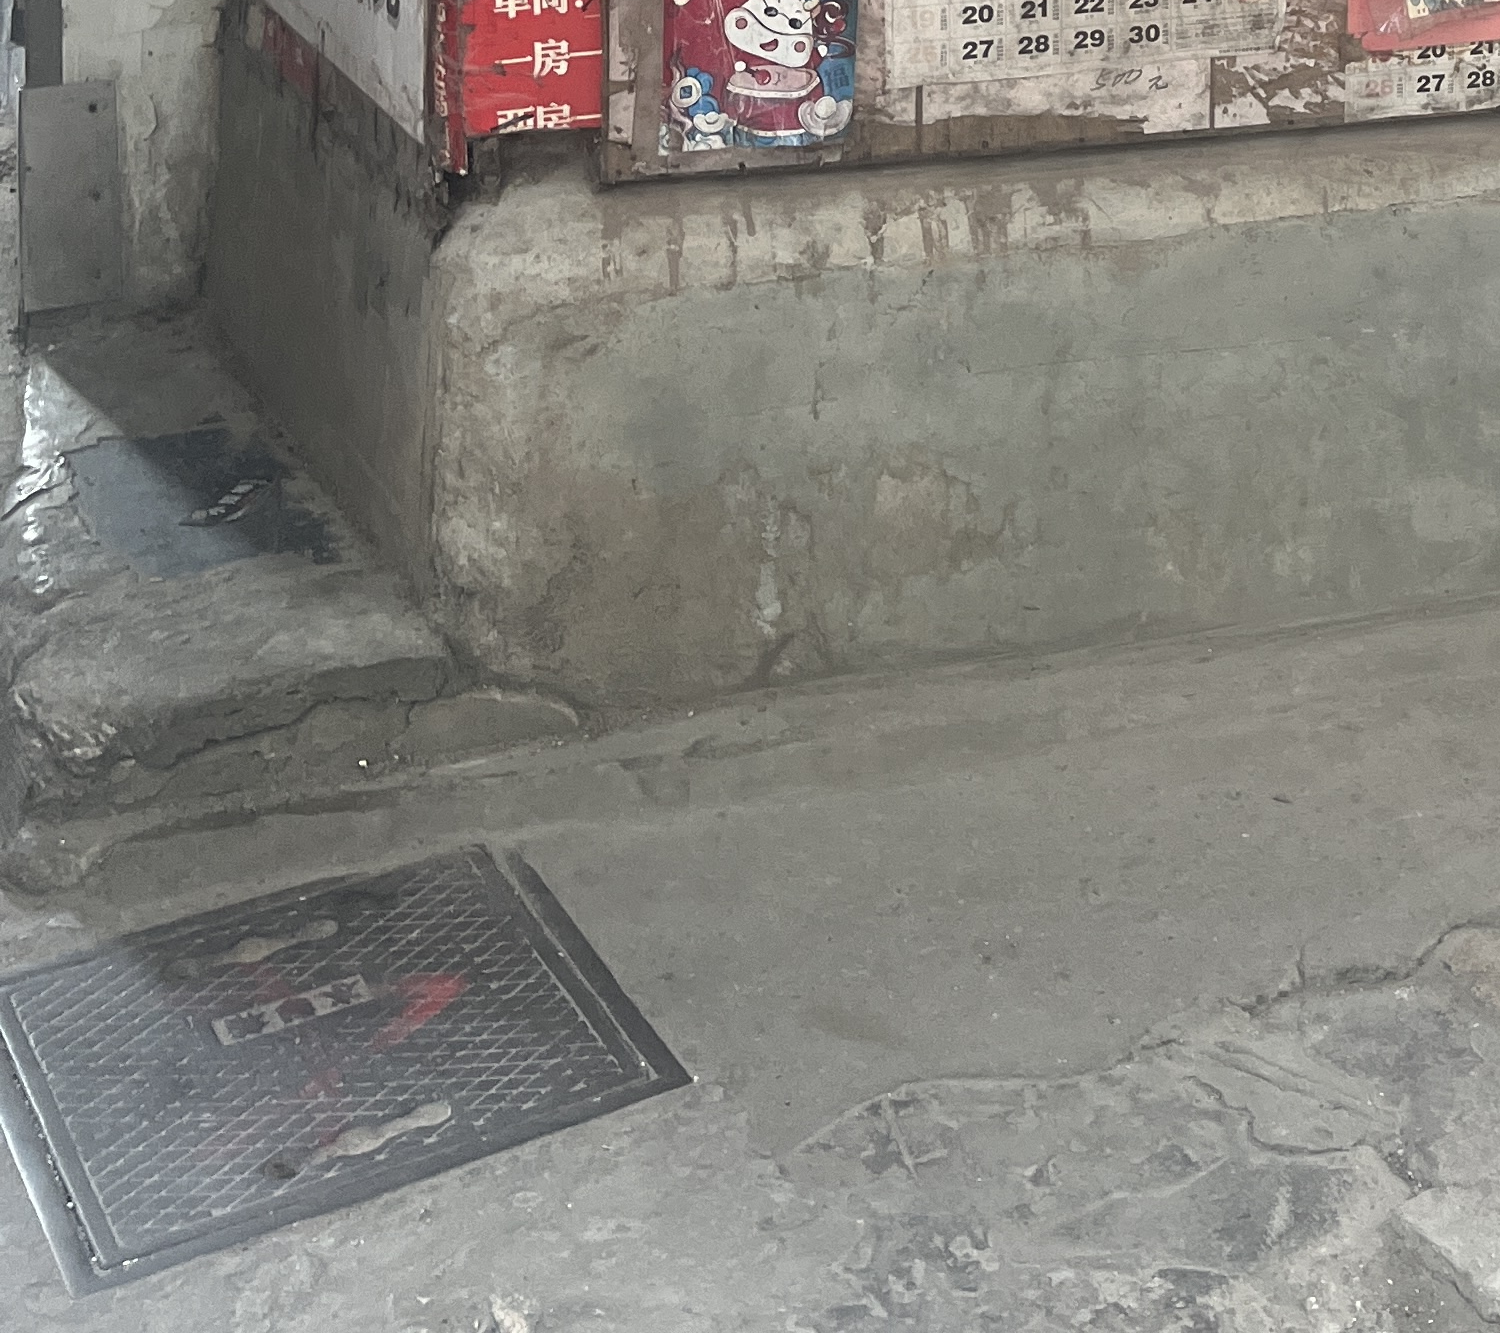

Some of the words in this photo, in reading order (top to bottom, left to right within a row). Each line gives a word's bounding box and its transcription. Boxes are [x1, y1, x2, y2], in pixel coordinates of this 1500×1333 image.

[961, 4, 995, 26] 20
[1020, 0, 1049, 21] 21
[960, 39, 995, 61] 27
[1017, 35, 1051, 56] 28
[1072, 30, 1106, 51] 29
[1128, 24, 1161, 45] 30
[1416, 74, 1446, 94] 27
[1466, 70, 1496, 90] 28
